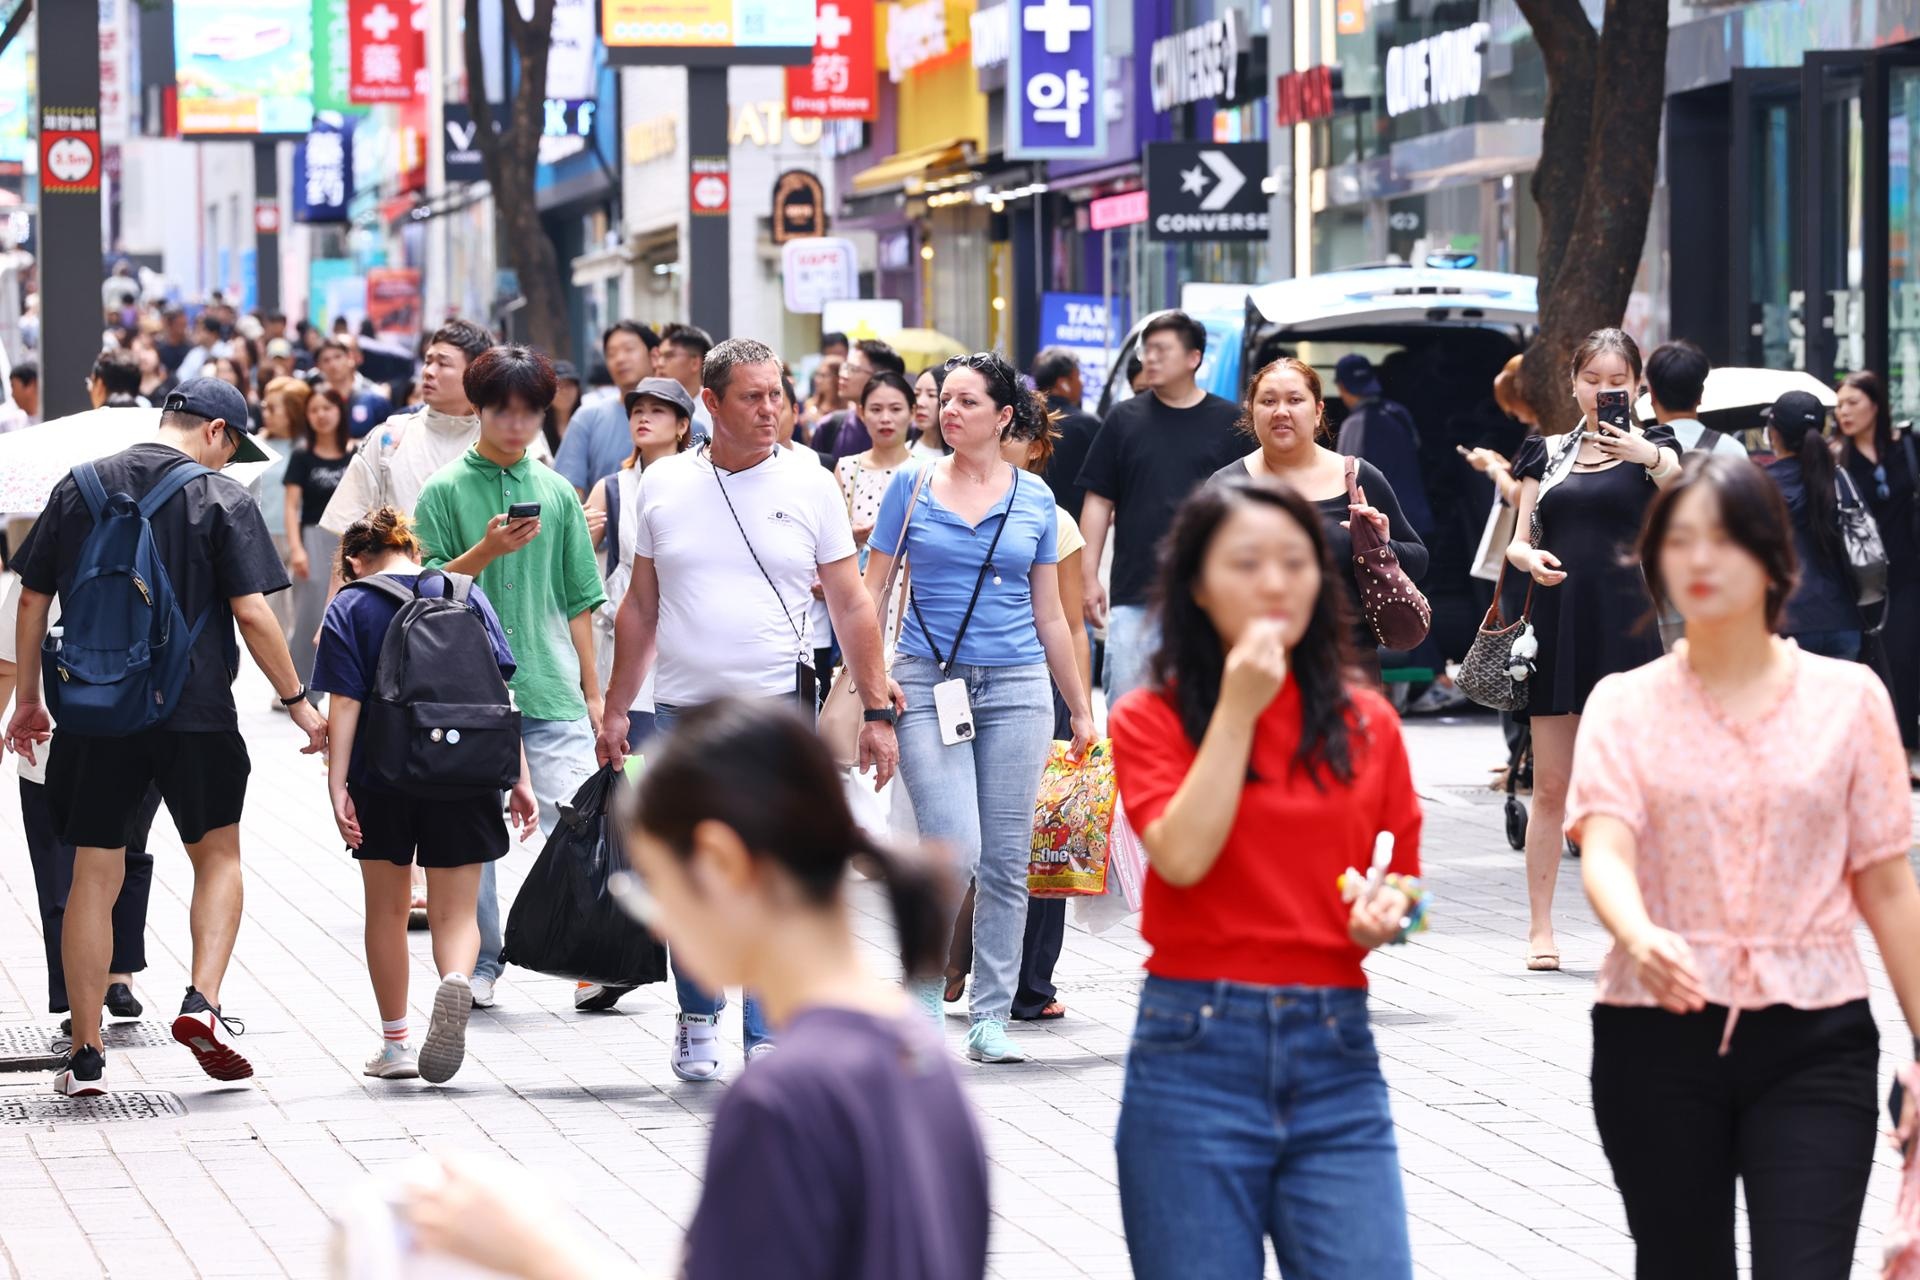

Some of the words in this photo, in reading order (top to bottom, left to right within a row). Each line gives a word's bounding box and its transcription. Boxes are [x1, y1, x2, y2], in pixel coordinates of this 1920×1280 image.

[792, 97, 827, 111] Drug
[830, 97, 868, 110] Store
[1026, 69, 1090, 139] 약
[1156, 213, 1270, 233] CONVERSE
[1064, 303, 1110, 326] TAX
[1031, 831, 1057, 849] HBAF
[1041, 847, 1069, 862] One
